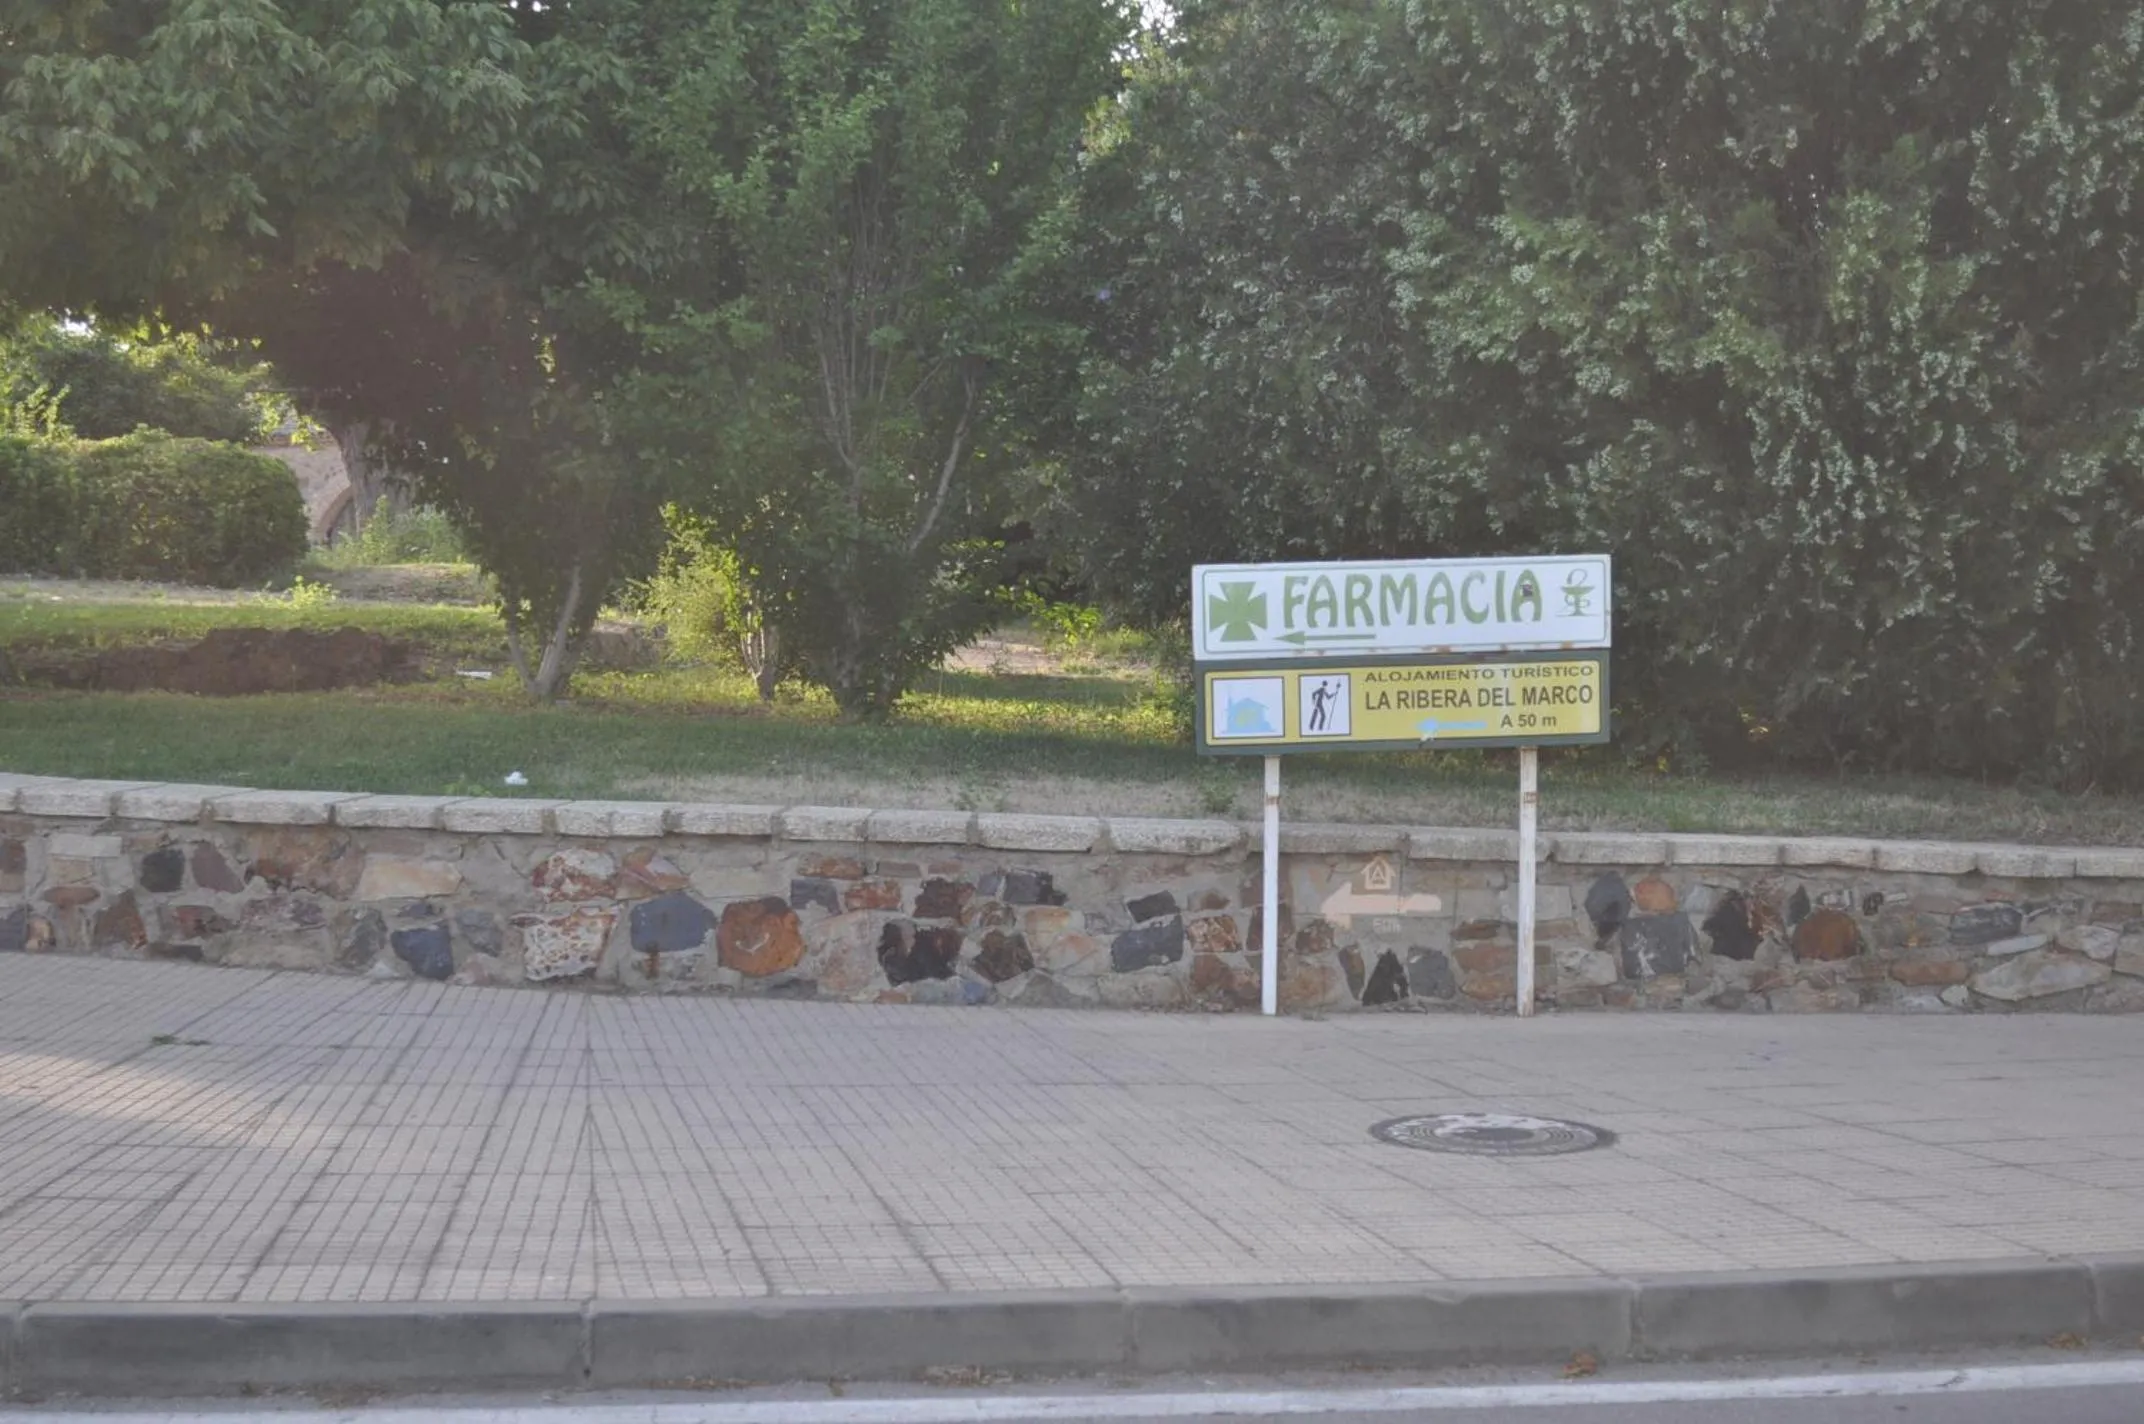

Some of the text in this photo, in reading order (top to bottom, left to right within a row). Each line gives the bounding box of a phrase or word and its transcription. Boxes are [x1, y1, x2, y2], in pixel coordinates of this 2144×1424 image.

[1283, 569, 1543, 629] FARMACIA
[1365, 669, 1495, 683] ALOJAMIENTO
[1365, 684, 1593, 710] LA RIBERA DEL MARCO
[1501, 714, 1557, 728] A 50 m
